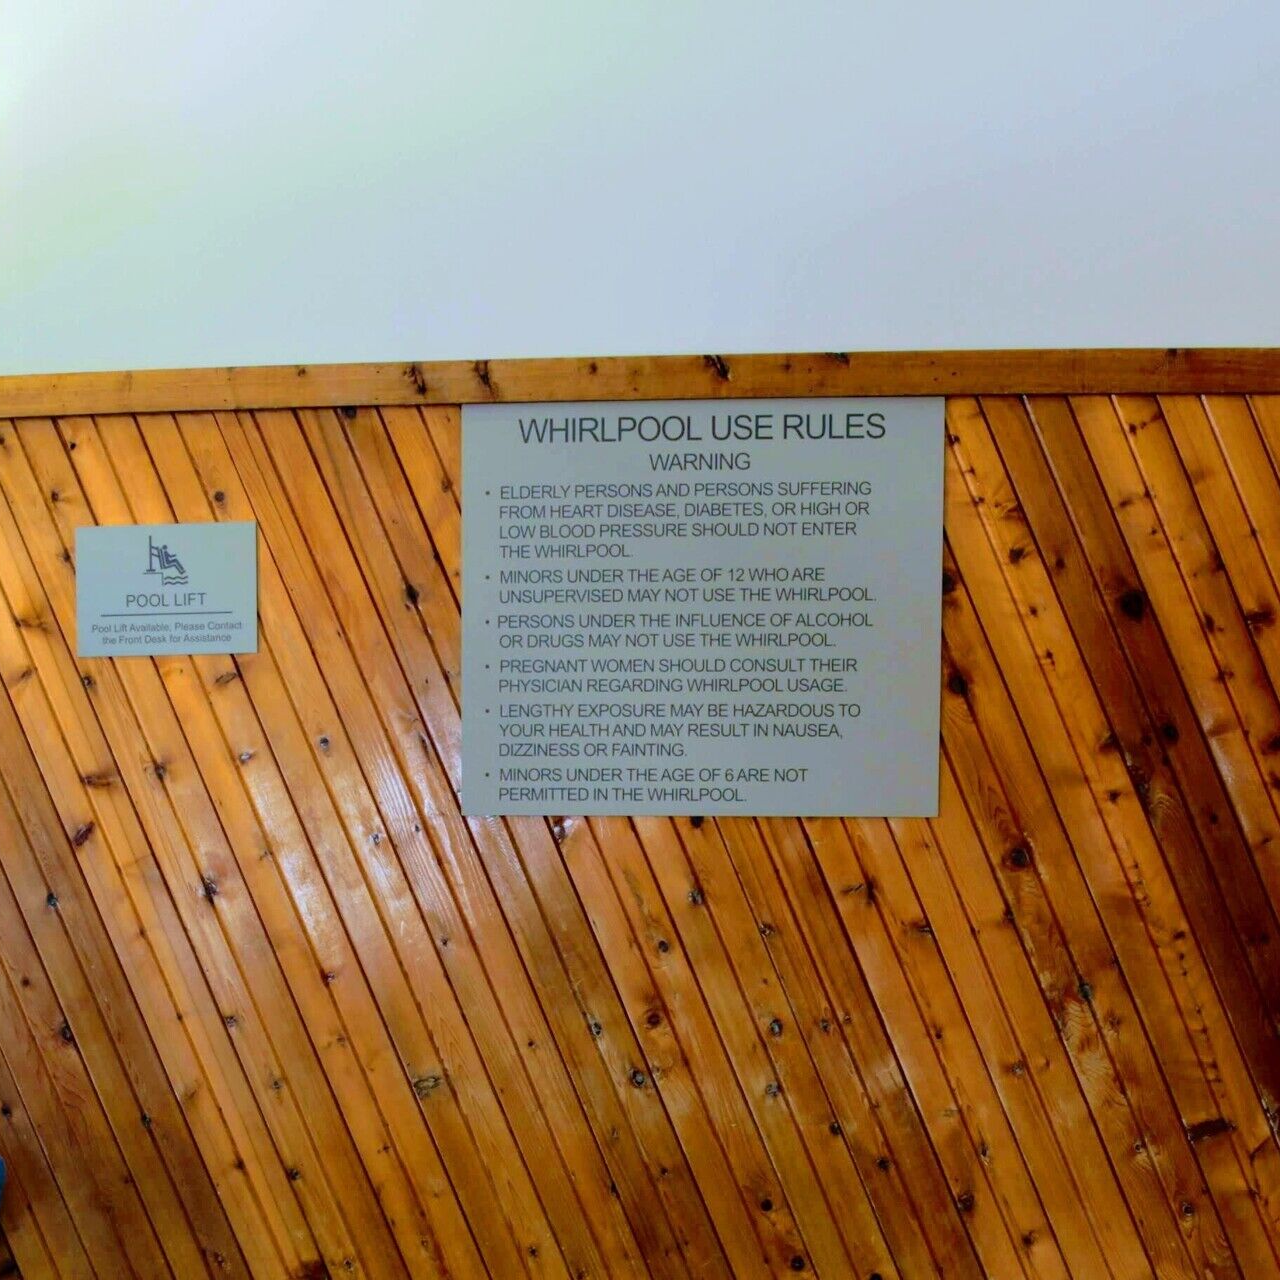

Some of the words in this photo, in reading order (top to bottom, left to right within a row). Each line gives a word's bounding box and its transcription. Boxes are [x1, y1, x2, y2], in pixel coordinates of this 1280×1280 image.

[519, 416, 702, 444] WHIRLPOOL
[712, 415, 773, 441] USE
[783, 413, 886, 440] RULES
[649, 452, 750, 471] WARNING
[501, 485, 570, 499] ELDERLY
[575, 484, 652, 498] PERSONS
[656, 483, 690, 497] AND
[695, 482, 773, 496] PERSONS
[778, 480, 871, 496] SUFFERING
[500, 505, 545, 519] FROM
[550, 504, 603, 518] HEART
[608, 503, 679, 518] DISEASE,
[685, 502, 766, 517] DIABETES,
[772, 502, 796, 516] OR
[801, 502, 840, 515] HIGH
[845, 502, 869, 515] OR
[500, 525, 536, 539] LOW
[540, 524, 595, 538] BLOOD
[600, 523, 687, 537] PRESSURE
[692, 523, 759, 537] SHOULD
[764, 522, 798, 536] NOT
[802, 522, 857, 536] ENTER
[499, 545, 530, 558] THE
[535, 544, 633, 558] WHIRLPOOL.
[500, 570, 563, 584] MINORS
[568, 569, 623, 583] UNDER
[627, 569, 659, 582] THE
[662, 568, 696, 582] AGE
[701, 568, 722, 582] OF
[729, 568, 744, 581] 12
[748, 568, 789, 582] WHO
[792, 568, 825, 581] ARE
[126, 594, 169, 608] POOL
[174, 593, 207, 606] LIFT
[500, 589, 623, 604] UNSUPERVISED
[628, 589, 661, 602] MAY
[665, 588, 699, 602] NOT
[703, 588, 735, 602] USE
[740, 588, 771, 601] THE
[776, 587, 876, 601] WHIRLPOOL.
[92, 624, 112, 634] Pool
[114, 623, 128, 633] Lift
[175, 621, 206, 631] Please
[207, 620, 242, 631] Contact
[498, 615, 574, 628] PERSONS
[579, 614, 635, 628] UNDER
[640, 614, 670, 627] THE
[676, 613, 765, 627] INFLUENCE
[770, 613, 792, 627] OF
[795, 613, 873, 627] ALCOHOL
[102, 636, 116, 645] the
[119, 635, 142, 645] Front
[144, 634, 167, 644] Desk
[169, 634, 182, 643] for
[184, 633, 232, 643] Assistance
[500, 635, 523, 648] OR
[527, 634, 584, 648] DRUGS
[589, 634, 621, 647] MAY
[626, 634, 659, 647] NOT
[663, 634, 695, 647] USE
[700, 633, 731, 647] THE
[735, 633, 836, 647] WHIRLPOOL.
[500, 659, 588, 673] PREGNANT
[591, 659, 654, 672] WOMEN
[659, 659, 726, 672] SHOULD
[730, 658, 806, 672] CONSULT
[809, 658, 857, 672] THEIR
[499, 679, 582, 693] PHYSICIAN
[587, 679, 683, 692] REGARDING
[687, 678, 783, 692] WHIRLPOOL
[788, 678, 847, 692] USAGE.
[500, 704, 574, 717] LENGTHY
[578, 704, 665, 717] EXPOSURE
[671, 704, 704, 717] MAY
[708, 704, 728, 717] BE
[734, 704, 834, 717] HAZARDOUS
[838, 704, 861, 717] TO
[499, 723, 544, 737] YOUR
[549, 723, 609, 737] HEALTH
[612, 724, 646, 737] AND
[651, 724, 684, 736] MAY
[688, 723, 750, 737] RESULT
[754, 724, 768, 737] IN
[773, 724, 842, 739] NAUSEA,
[499, 743, 580, 756] DIZZINESS
[584, 743, 608, 756] OR
[612, 743, 687, 757] FAINTING.
[500, 768, 562, 782] MINORS
[567, 768, 623, 781] UNDER
[626, 768, 657, 781] THE
[661, 768, 695, 782] AGE
[699, 768, 721, 782] OF
[725, 768, 734, 782] 6
[736, 768, 769, 782] ARE
[774, 768, 808, 782] NOT
[499, 788, 589, 801] PERMITTED
[593, 788, 608, 801] IN
[612, 788, 643, 801] THE
[648, 788, 746, 801] WHIRLPOOL.
